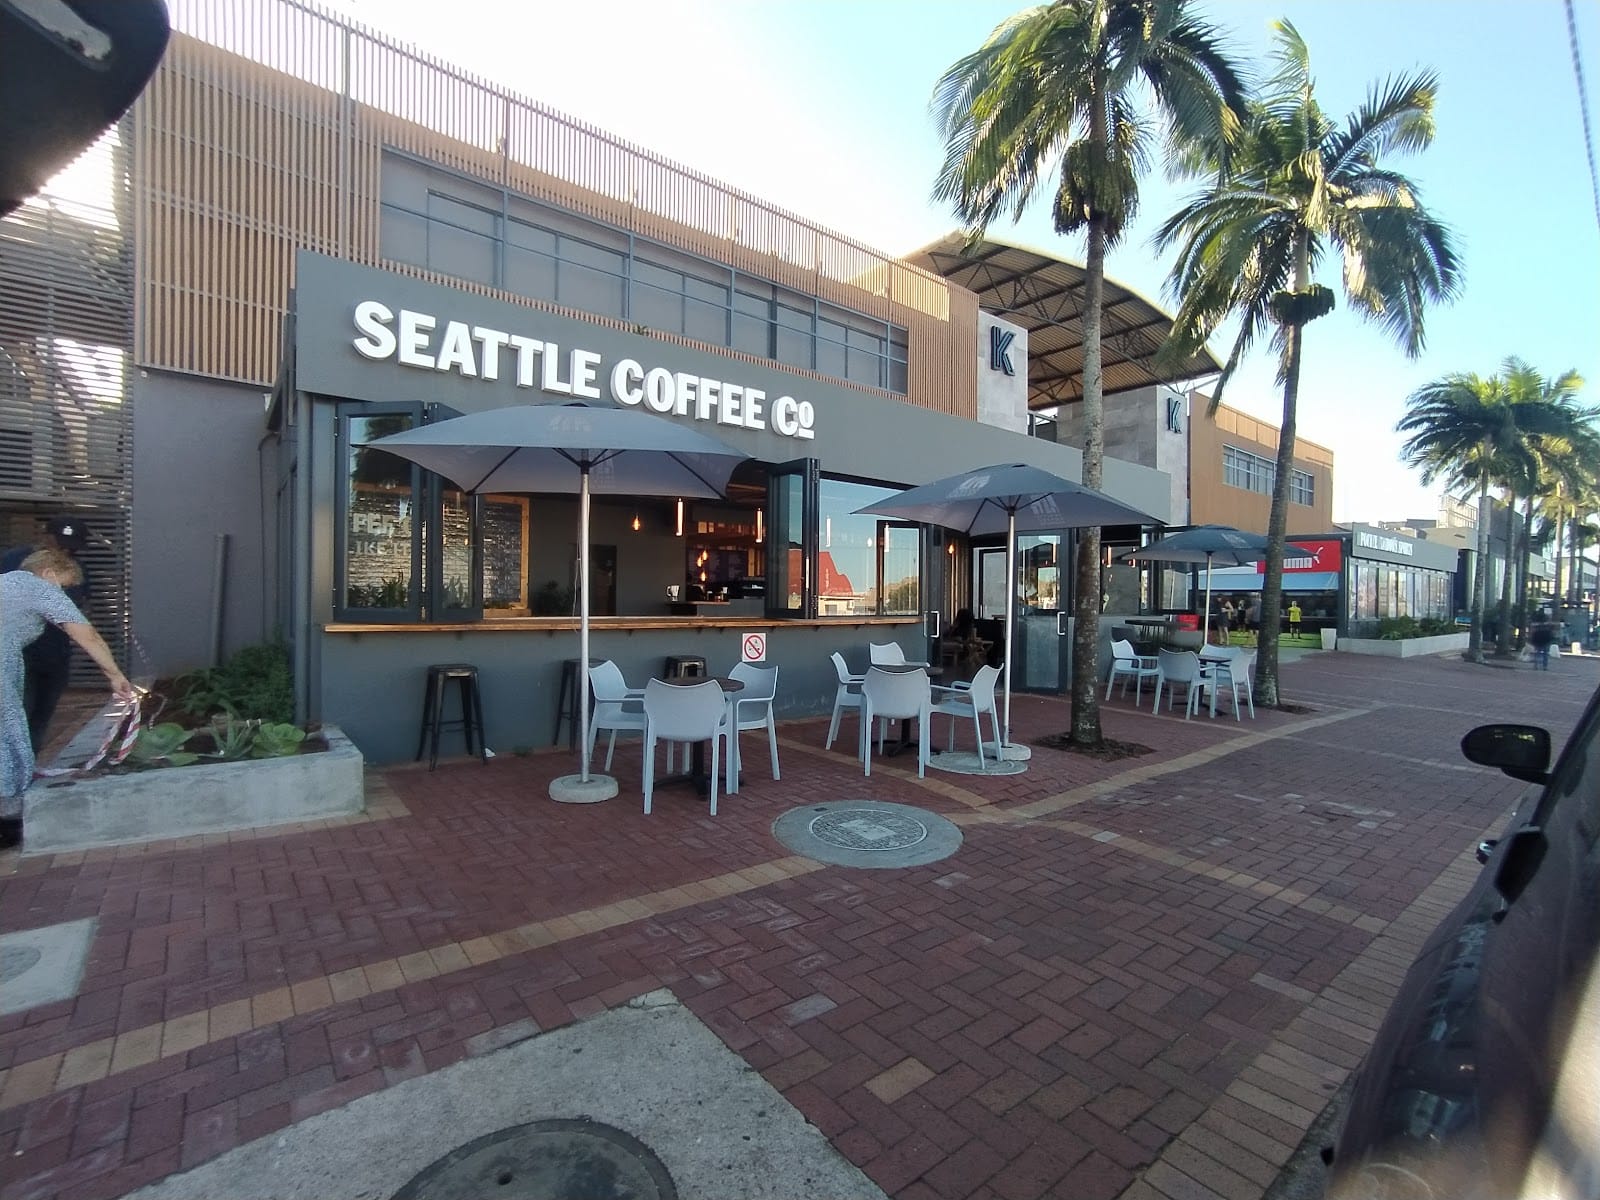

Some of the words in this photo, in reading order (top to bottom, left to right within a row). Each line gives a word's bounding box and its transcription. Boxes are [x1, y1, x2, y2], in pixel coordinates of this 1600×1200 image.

[352, 300, 601, 399] SEATTLE
[610, 358, 766, 431] COFFEE
[990, 325, 1017, 377] K
[1167, 397, 1183, 434] K
